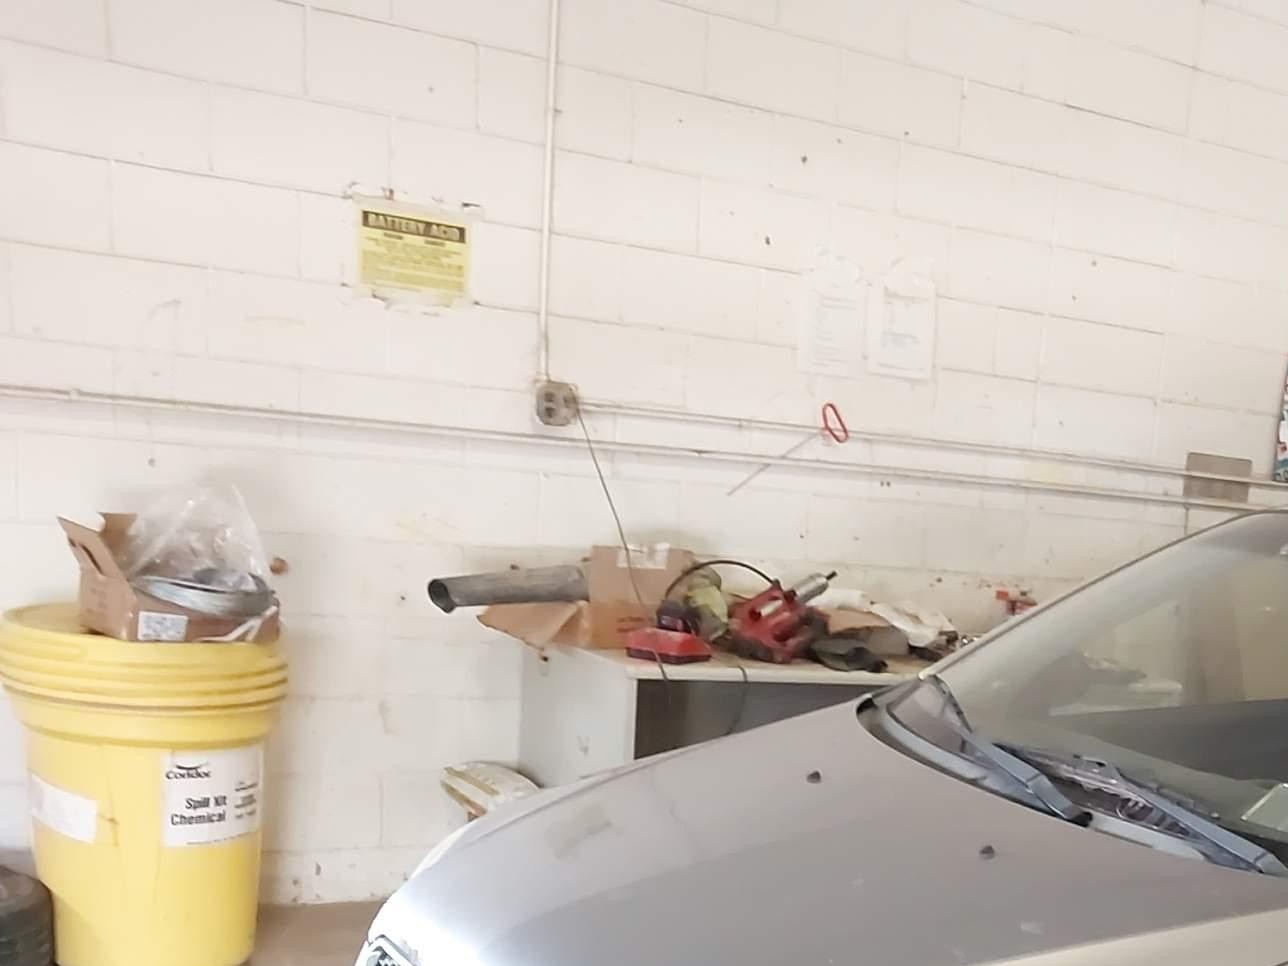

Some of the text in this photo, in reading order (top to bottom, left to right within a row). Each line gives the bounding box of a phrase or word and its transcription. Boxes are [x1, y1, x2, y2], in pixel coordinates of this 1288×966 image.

[368, 213, 461, 241] BATTERY ACID
[185, 794, 227, 810] Spill Kit
[171, 809, 226, 826] Chemical
